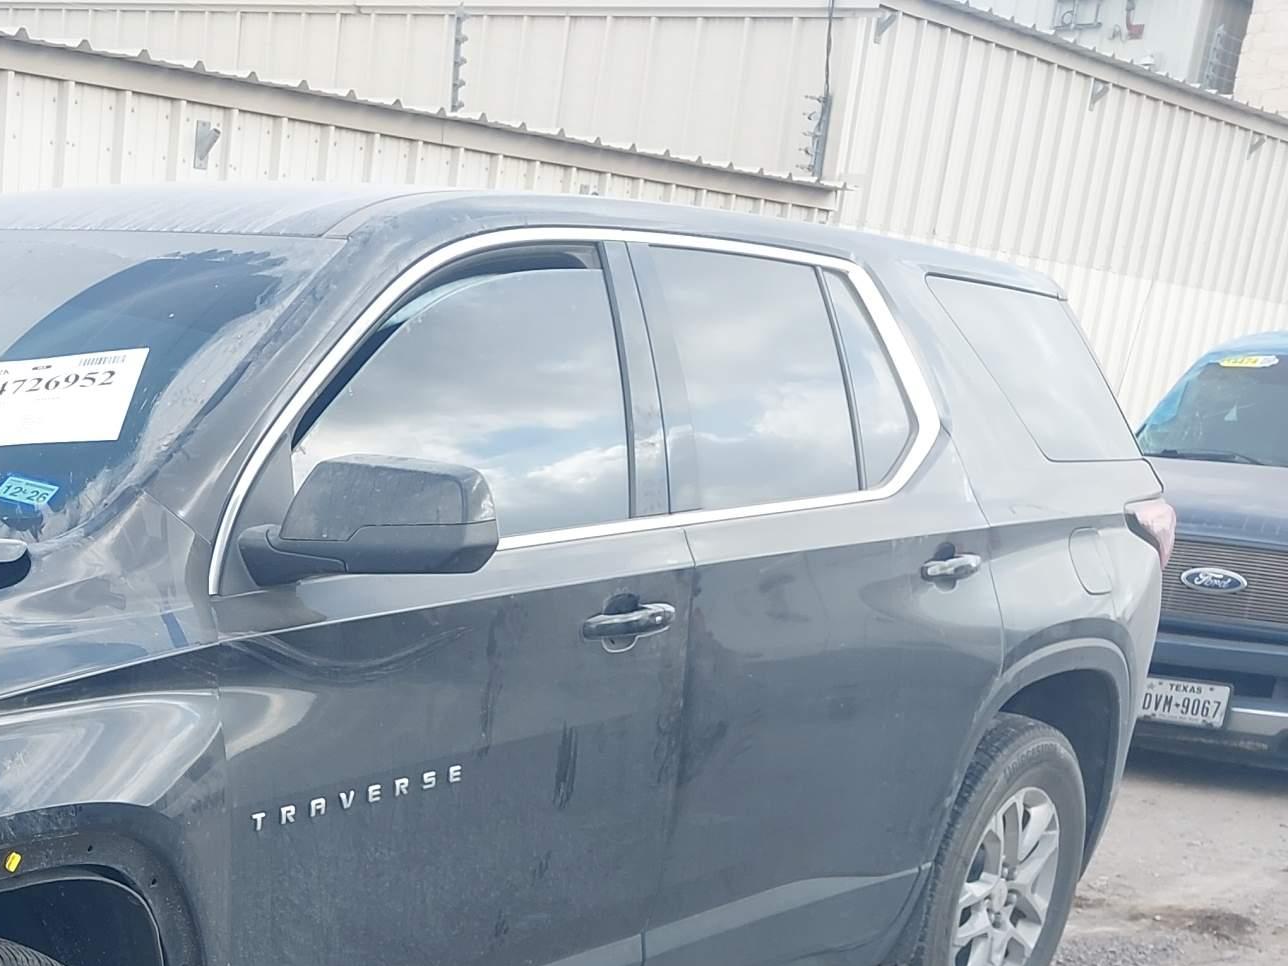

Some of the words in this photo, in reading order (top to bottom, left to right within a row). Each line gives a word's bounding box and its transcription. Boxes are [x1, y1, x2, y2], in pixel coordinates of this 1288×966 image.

[1193, 572, 1232, 589] Ford
[1169, 683, 1202, 694] TEXAS
[250, 764, 463, 832] TRAVERSE
